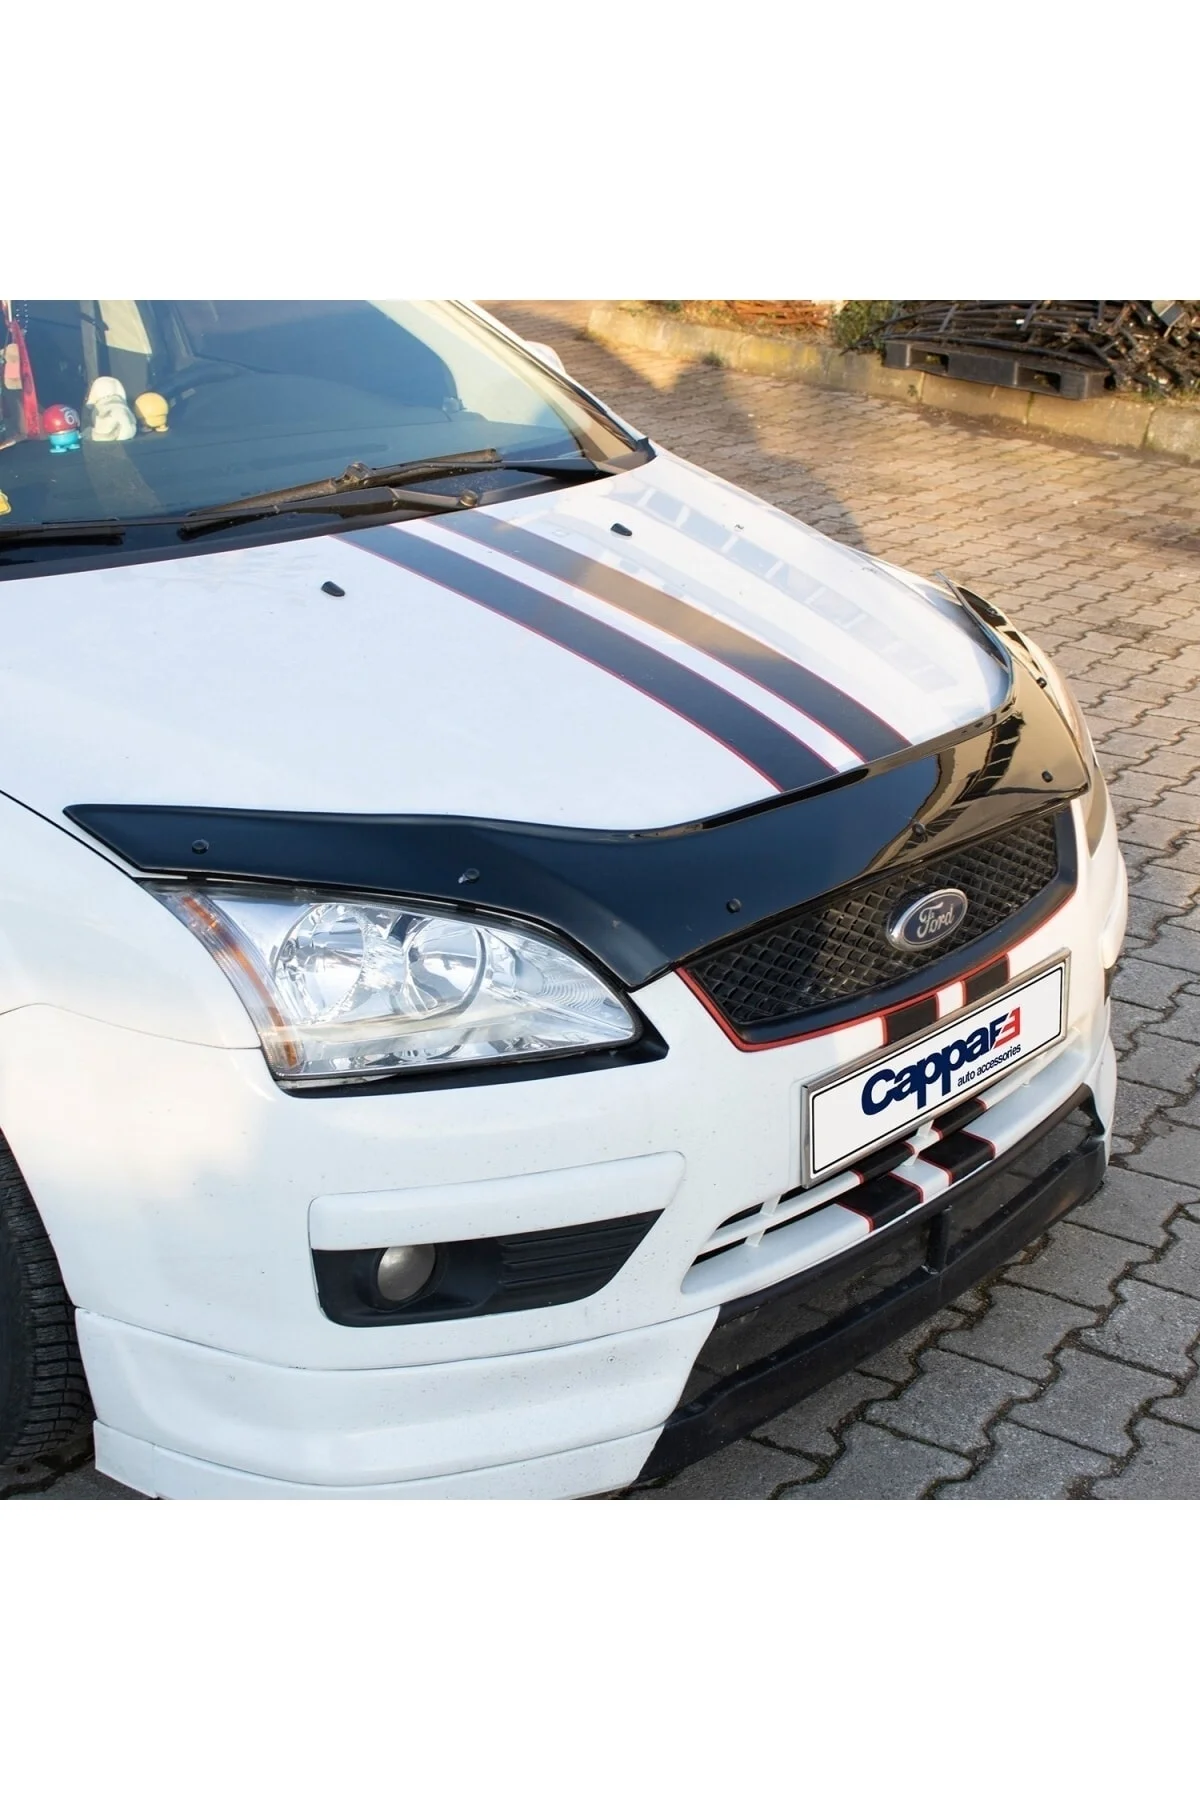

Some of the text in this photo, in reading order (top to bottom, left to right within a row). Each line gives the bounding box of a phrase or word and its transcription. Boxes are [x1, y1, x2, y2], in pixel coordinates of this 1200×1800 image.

[917, 902, 954, 938] Ford
[957, 1044, 1021, 1087] auto accessories
